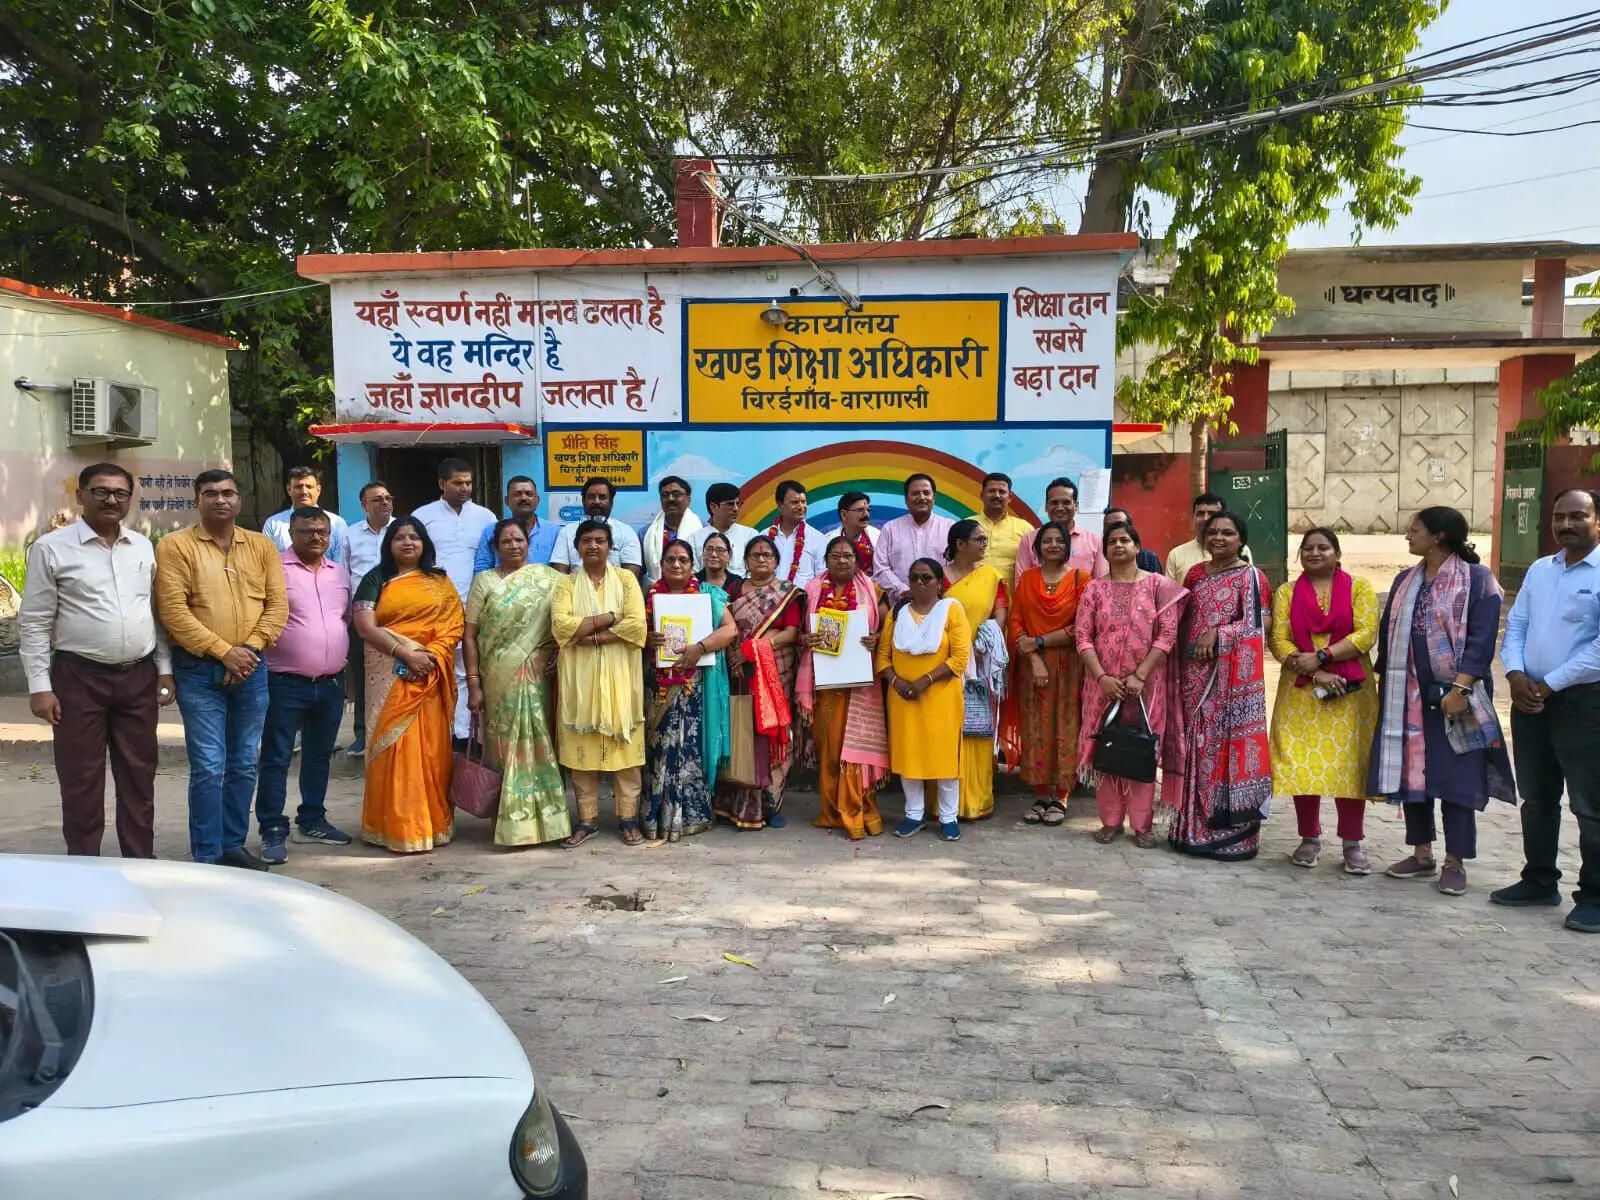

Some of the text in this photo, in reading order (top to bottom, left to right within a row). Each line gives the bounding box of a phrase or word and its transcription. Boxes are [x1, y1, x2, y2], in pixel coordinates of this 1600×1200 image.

[354, 286, 666, 335] यहाँ स्वर्ण नहीं मानव ढलता है
[1013, 286, 1111, 320] शिक्षा दान
[784, 309, 900, 335] कार्यालय
[1033, 322, 1087, 354] सबसे
[390, 327, 564, 374] ये वह मन्दिर है
[694, 338, 989, 385] खण्ड शिक्षा अधिकारी
[364, 372, 414, 415] जहाँ
[417, 372, 523, 415] ज्ञानदीप
[541, 379, 618, 409] जलता
[1012, 365, 1100, 397] बड़ा दान
[561, 433, 621, 452] प्रीति सिंह
